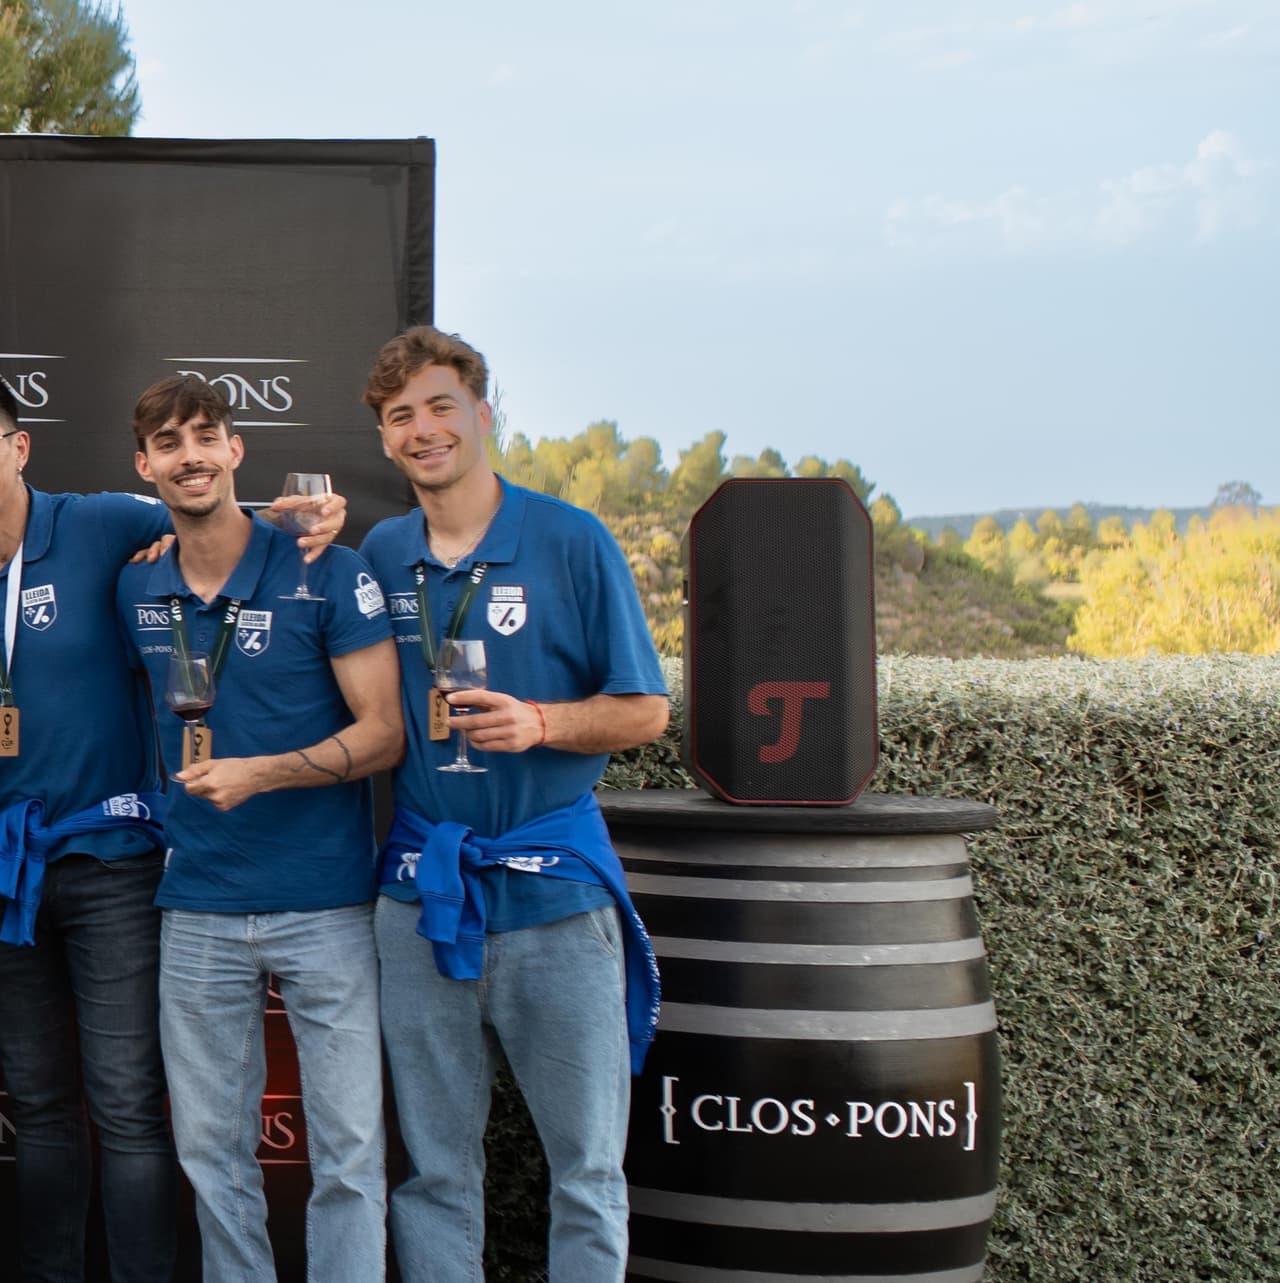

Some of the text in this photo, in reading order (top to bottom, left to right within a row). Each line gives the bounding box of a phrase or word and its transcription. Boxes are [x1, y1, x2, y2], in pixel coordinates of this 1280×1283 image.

[176, 370, 293, 412] ONS
[24, 587, 51, 601] LLEIDA
[137, 608, 171, 625] PONS
[691, 1094, 957, 1138] CLOS PONS
